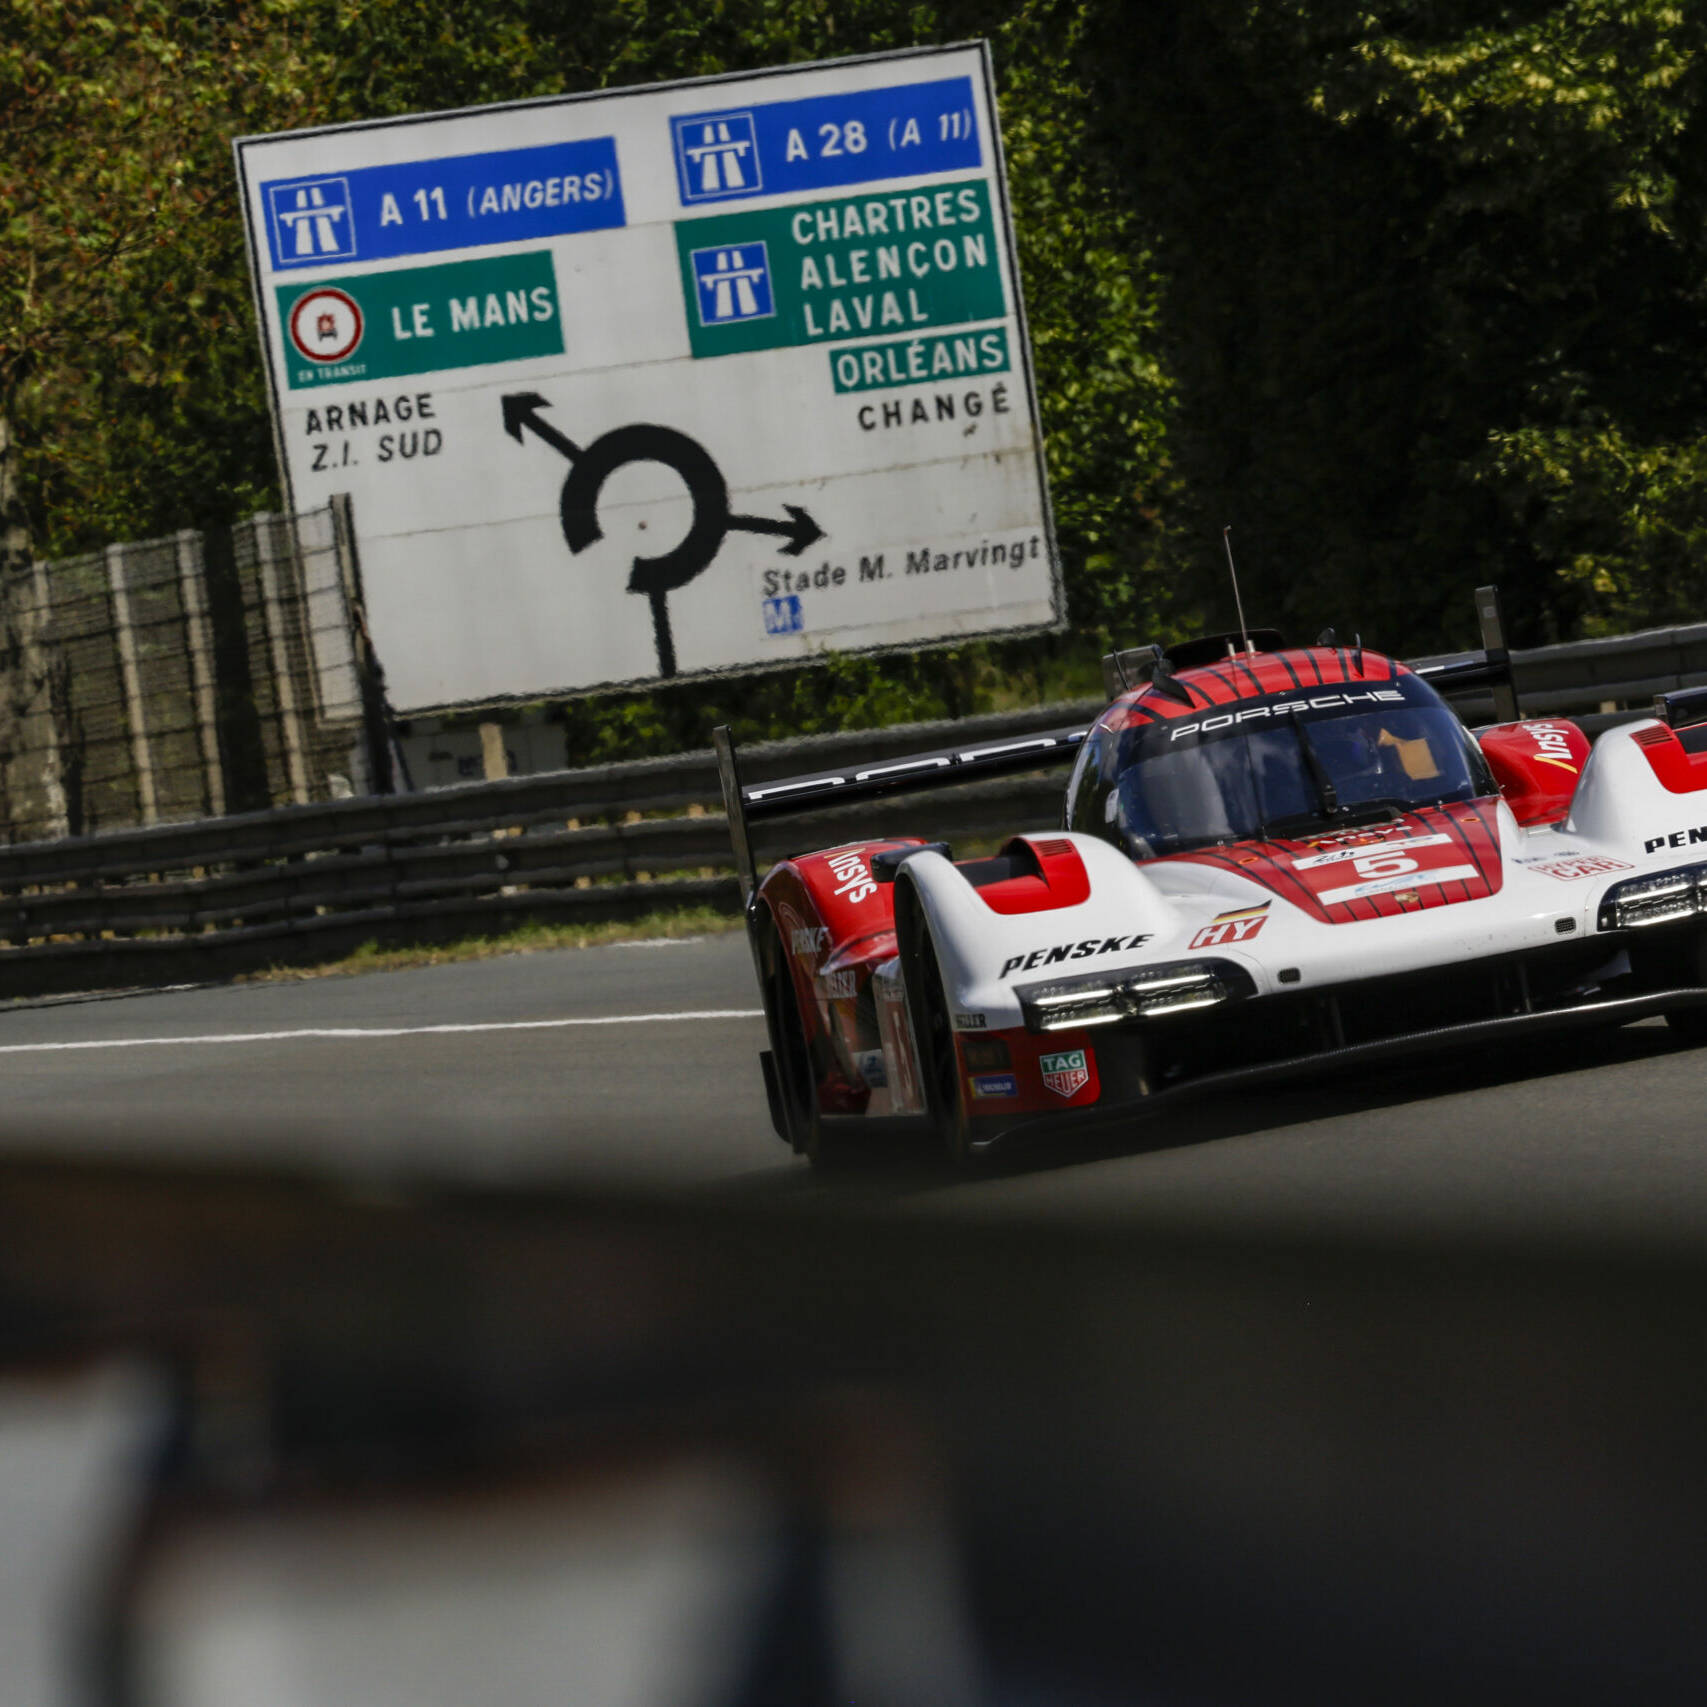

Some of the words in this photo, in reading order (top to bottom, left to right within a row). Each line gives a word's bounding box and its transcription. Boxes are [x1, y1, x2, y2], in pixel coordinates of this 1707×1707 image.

[786, 128, 809, 162] A
[819, 120, 868, 157] 28
[888, 116, 922, 151] (A
[938, 108, 972, 142] 11)
[380, 193, 403, 227] A
[413, 186, 448, 221] 11
[467, 168, 614, 218] (ANGERS)
[791, 188, 982, 246] CHARTRES
[801, 234, 988, 291] ALENÇON
[392, 304, 435, 341] LE
[449, 286, 554, 332] MANS
[803, 289, 929, 337] LAVAL
[837, 334, 1005, 388] ORLÉANS
[306, 392, 436, 436] ARNAGE
[857, 381, 1011, 432] CHANGÉ
[311, 440, 359, 472] Z.I.
[377, 428, 442, 463] SUD
[763, 562, 847, 597] Stade
[858, 553, 893, 582] M.
[905, 535, 1040, 569] Marvingt
[1170, 690, 1406, 742] PORSCHE
[1352, 850, 1419, 879] 5
[1551, 861, 1625, 878] CAR
[998, 933, 1155, 980] PENSKE
[1192, 916, 1263, 948] HY
[1043, 1054, 1082, 1071] TAG
[1045, 1070, 1086, 1093] HEUER
